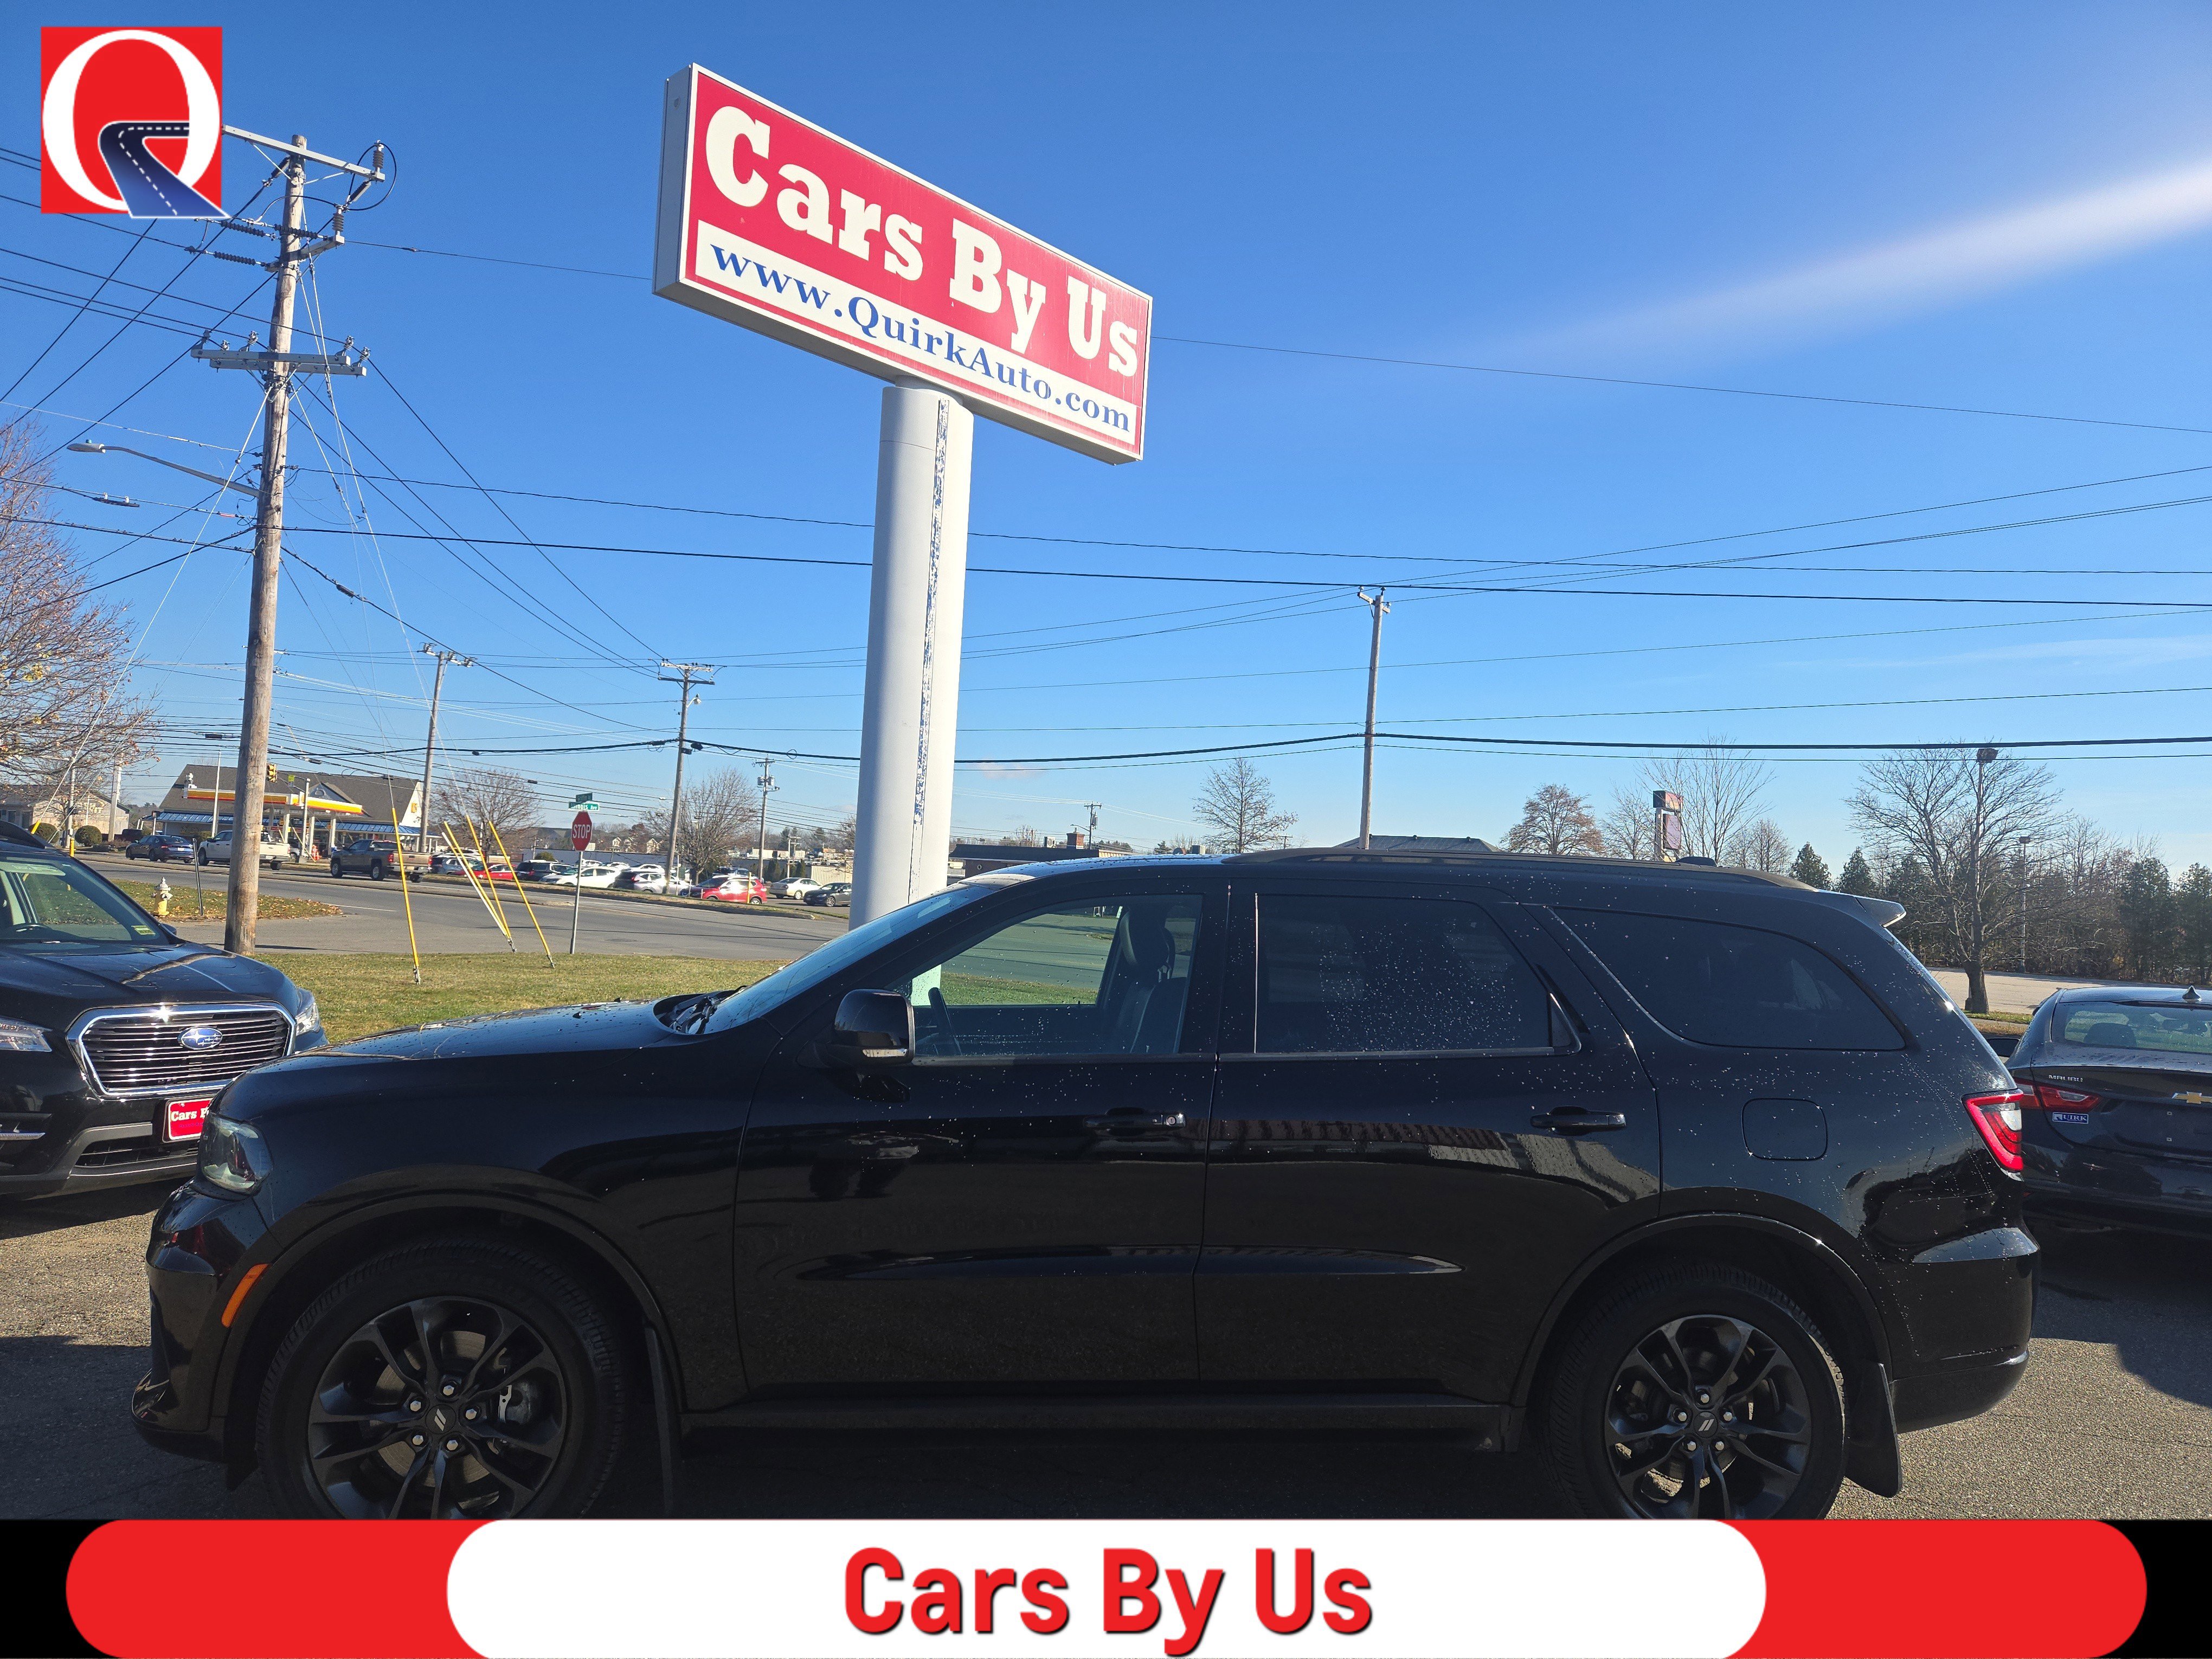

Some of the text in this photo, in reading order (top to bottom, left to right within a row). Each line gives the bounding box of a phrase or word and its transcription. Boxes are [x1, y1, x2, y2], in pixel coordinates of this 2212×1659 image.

[705, 105, 1139, 377] Cars By Us
[710, 243, 1131, 433] www.QuirkAuto.com
[573, 824, 590, 839] STOP
[171, 1111, 197, 1121] Cars
